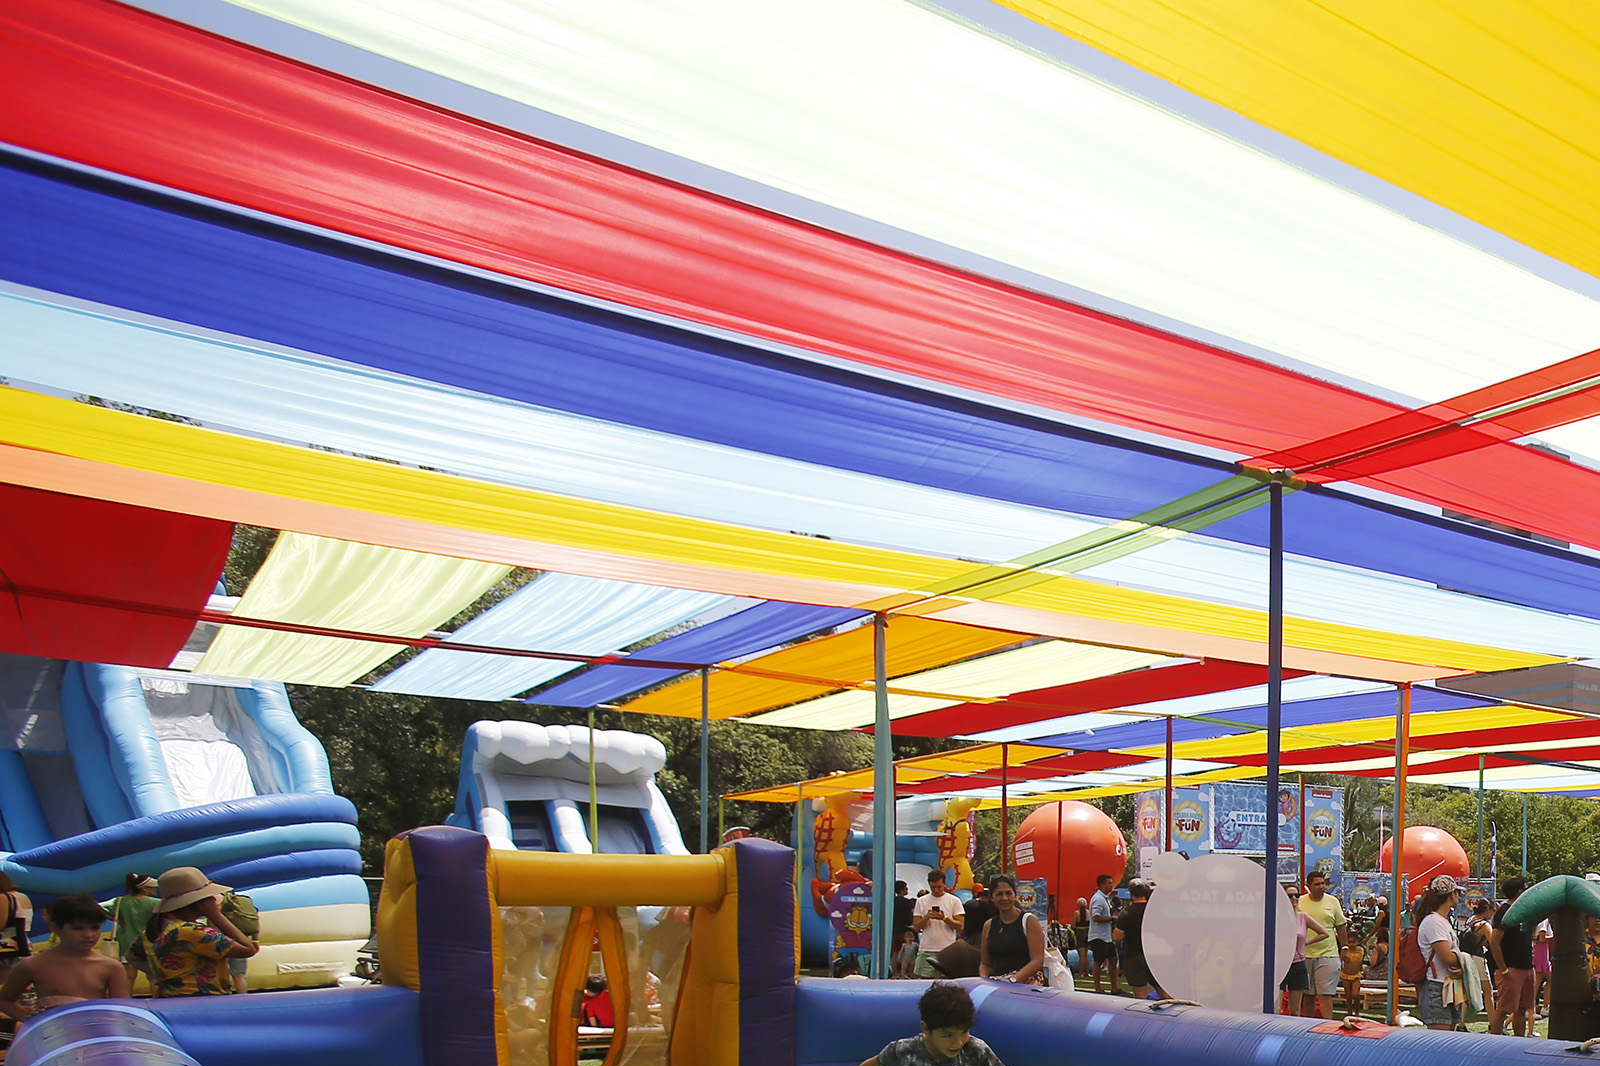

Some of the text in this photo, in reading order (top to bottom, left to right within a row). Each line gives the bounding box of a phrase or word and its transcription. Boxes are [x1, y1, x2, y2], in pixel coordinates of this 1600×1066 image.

[1142, 816, 1156, 830] FUN
[1236, 813, 1267, 823] ENTRA
[1175, 819, 1200, 831] FUN
[1311, 825, 1333, 838] FUN
